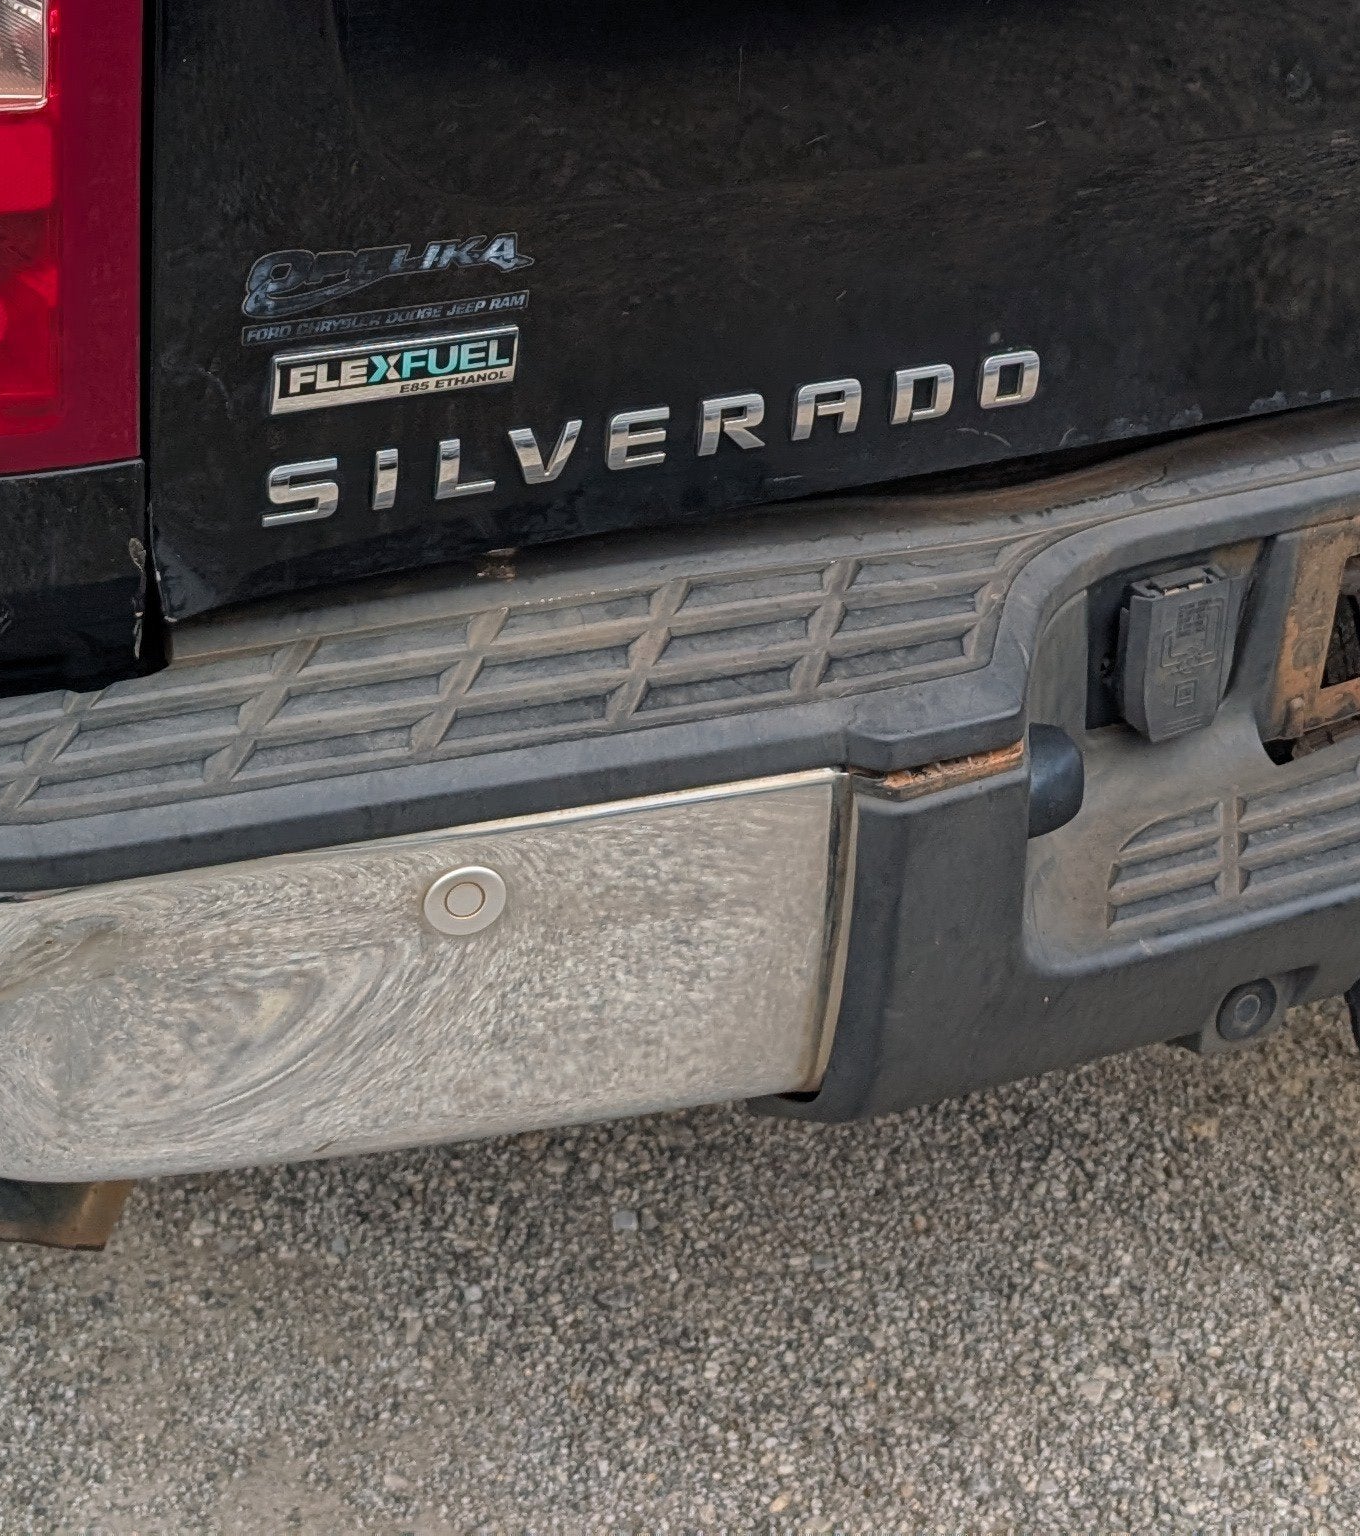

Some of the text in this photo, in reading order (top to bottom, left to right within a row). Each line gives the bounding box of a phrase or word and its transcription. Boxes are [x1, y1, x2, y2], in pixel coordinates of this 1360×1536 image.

[247, 293, 526, 343] FORD CHRYSLER DODGE JEEP RAM
[289, 339, 510, 393] FLEXFUEL
[399, 369, 508, 395] E85 ETHANOL
[261, 349, 1041, 528] SILVERADO
